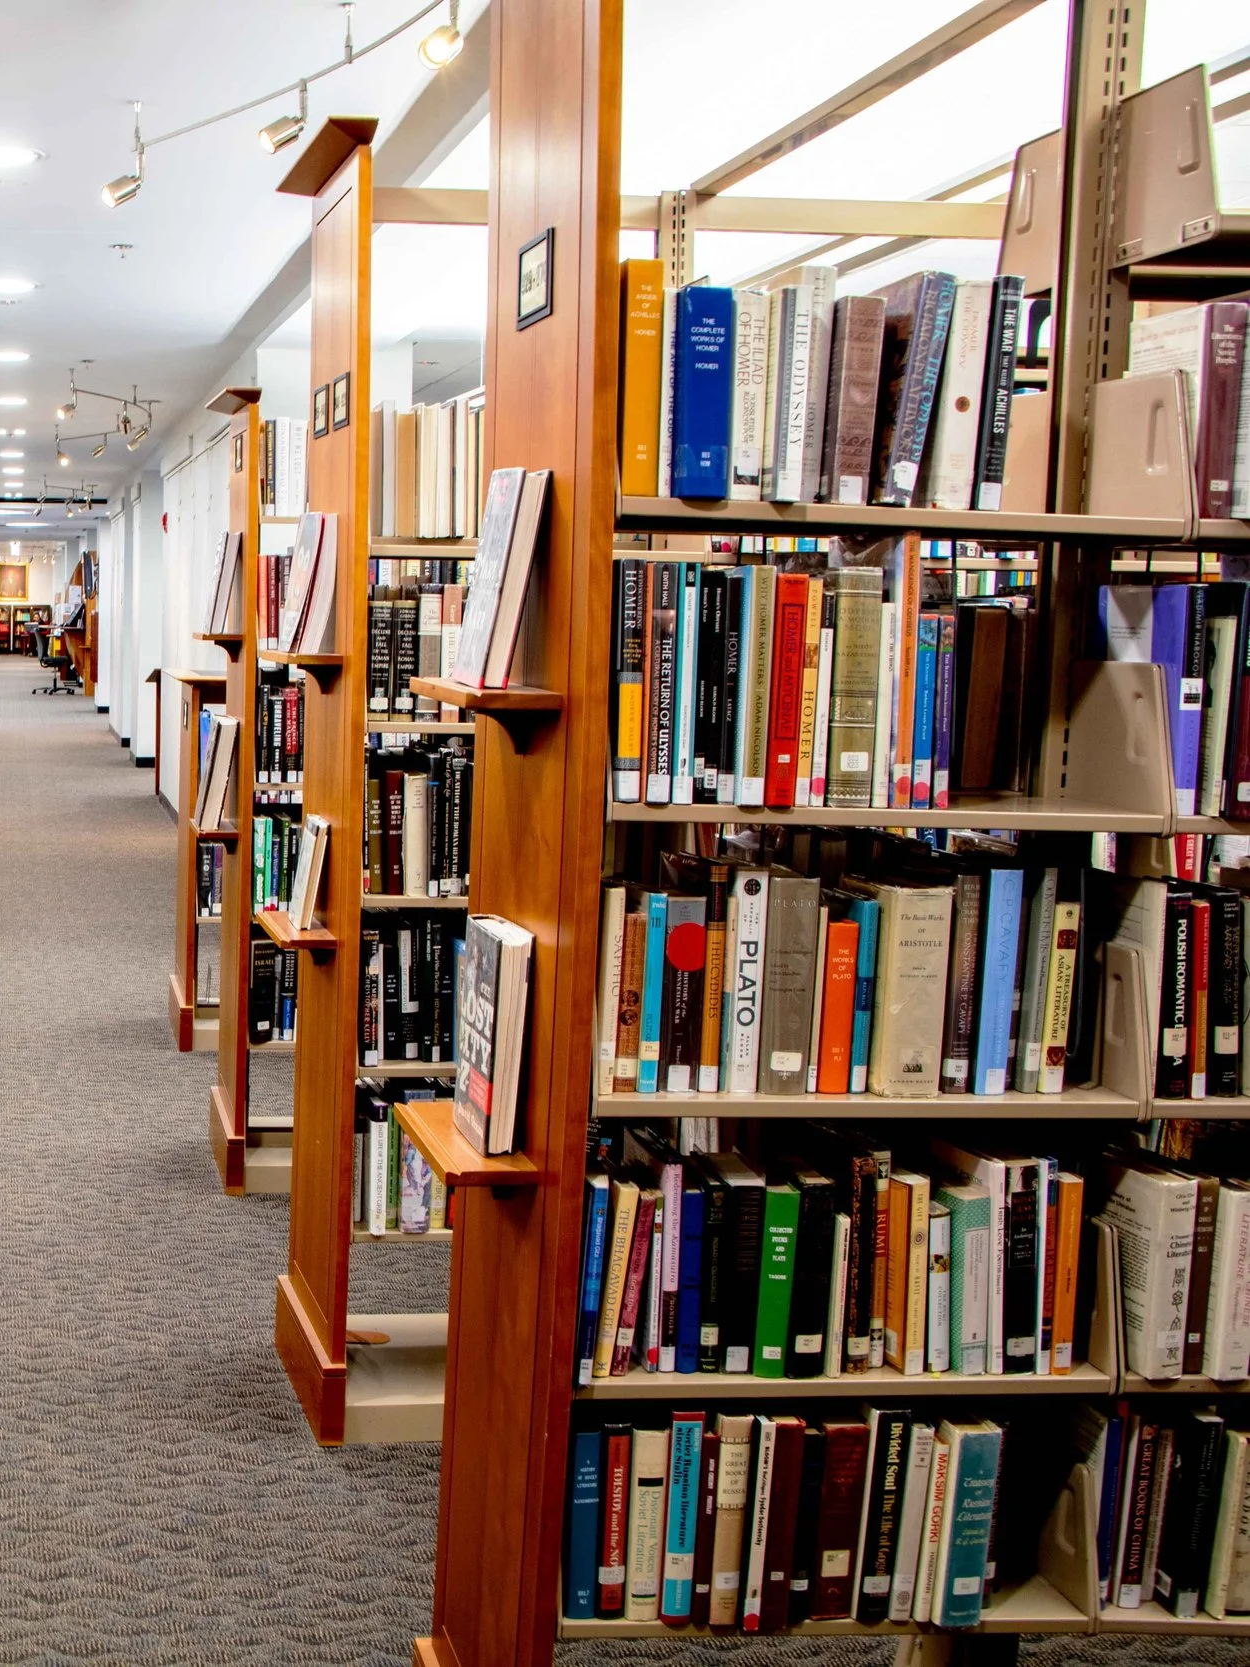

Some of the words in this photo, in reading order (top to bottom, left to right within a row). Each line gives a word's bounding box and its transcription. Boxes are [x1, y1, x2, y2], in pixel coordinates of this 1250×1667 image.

[739, 312, 752, 331] OF
[932, 280, 955, 341] HOMER
[1003, 308, 1017, 329] THE
[1223, 324, 1234, 333] The
[690, 327, 725, 335] COMPLETE
[695, 344, 719, 352] HOMER
[753, 316, 766, 344] THE
[796, 310, 809, 350] THE
[1001, 329, 1015, 352] WAR
[695, 362, 718, 370] HOMER
[737, 334, 750, 387] HOMER
[751, 347, 764, 385] ILIAD
[923, 356, 940, 386] THE
[999, 369, 1008, 386] KILLED
[1001, 355, 1009, 368] THAT
[790, 360, 806, 448] ODYSSEY
[993, 388, 1008, 434] ACHILLES
[805, 402, 817, 448] HOMER
[910, 391, 933, 462] ODYSSEY
[661, 590, 669, 607] HALL
[662, 571, 670, 589] EDITH
[760, 577, 768, 602] WHY
[624, 570, 637, 630] HOMER
[636, 570, 644, 630] REDISCOVERING
[810, 588, 819, 628] POWELL
[1193, 588, 1205, 626] VLADIMIR
[759, 604, 767, 640] HOMER
[786, 611, 798, 653] HOMER
[662, 638, 673, 661] THE
[727, 632, 738, 675] HOMER
[757, 642, 766, 685] MATTERS
[1191, 629, 1203, 678] NABOKOV
[660, 662, 672, 709] RETURN
[272, 705, 281, 747] UNRAVELING
[660, 710, 670, 727] OF
[800, 690, 815, 760] HOMER
[658, 728, 670, 775] ULYSSES
[752, 728, 761, 777] NICOLSON
[774, 899, 816, 908] PLATO
[899, 940, 943, 948] ARISTOTLE
[995, 912, 1012, 984] CAVAFY
[1177, 919, 1187, 960] POLISH
[708, 940, 722, 1019] THUCYDIDES
[961, 932, 972, 991] CONSTANTINE
[1056, 953, 1065, 984] ASIAN
[738, 940, 759, 1027] PLATO
[1061, 974, 1070, 1018] TREASURY
[1175, 962, 1186, 1023] ROMANTIC
[459, 987, 495, 1038] LOST
[958, 1003, 967, 1035] CAVAFY
[1051, 986, 1063, 1040] LITERATURE
[459, 1021, 492, 1073] CITY
[672, 1173, 681, 1215] Redeeming
[916, 1194, 924, 1205] THE
[618, 1209, 630, 1233] THE
[876, 1214, 887, 1254] RUMI
[669, 1234, 678, 1284] Kamasutra
[1236, 1214, 1250, 1280] LITERATURE
[606, 1237, 627, 1304] BHAGAVAD
[675, 1427, 684, 1454] since
[684, 1427, 693, 1456] Soviet
[887, 1423, 903, 1462] Divided
[1141, 1443, 1153, 1476] GREAT
[612, 1465, 623, 1512] TOLSTOY
[673, 1456, 682, 1485] Stalin
[681, 1459, 692, 1499] Russian
[884, 1465, 898, 1490] Soul
[934, 1453, 947, 1501] MAKSIM
[639, 1489, 650, 1520] Soviet
[649, 1490, 661, 1539] Dissonant
[883, 1494, 896, 1512] The
[1135, 1480, 1149, 1515] BOOKS
[610, 1532, 619, 1547] the
[611, 1513, 619, 1530] and
[679, 1501, 690, 1548] literature
[881, 1516, 893, 1532] Life
[929, 1506, 942, 1544] GORKI
[1134, 1517, 1145, 1529] OF
[635, 1525, 647, 1573] Literature
[647, 1543, 657, 1573] Voices
[879, 1536, 891, 1546] of
[1129, 1534, 1141, 1570] CHINA
